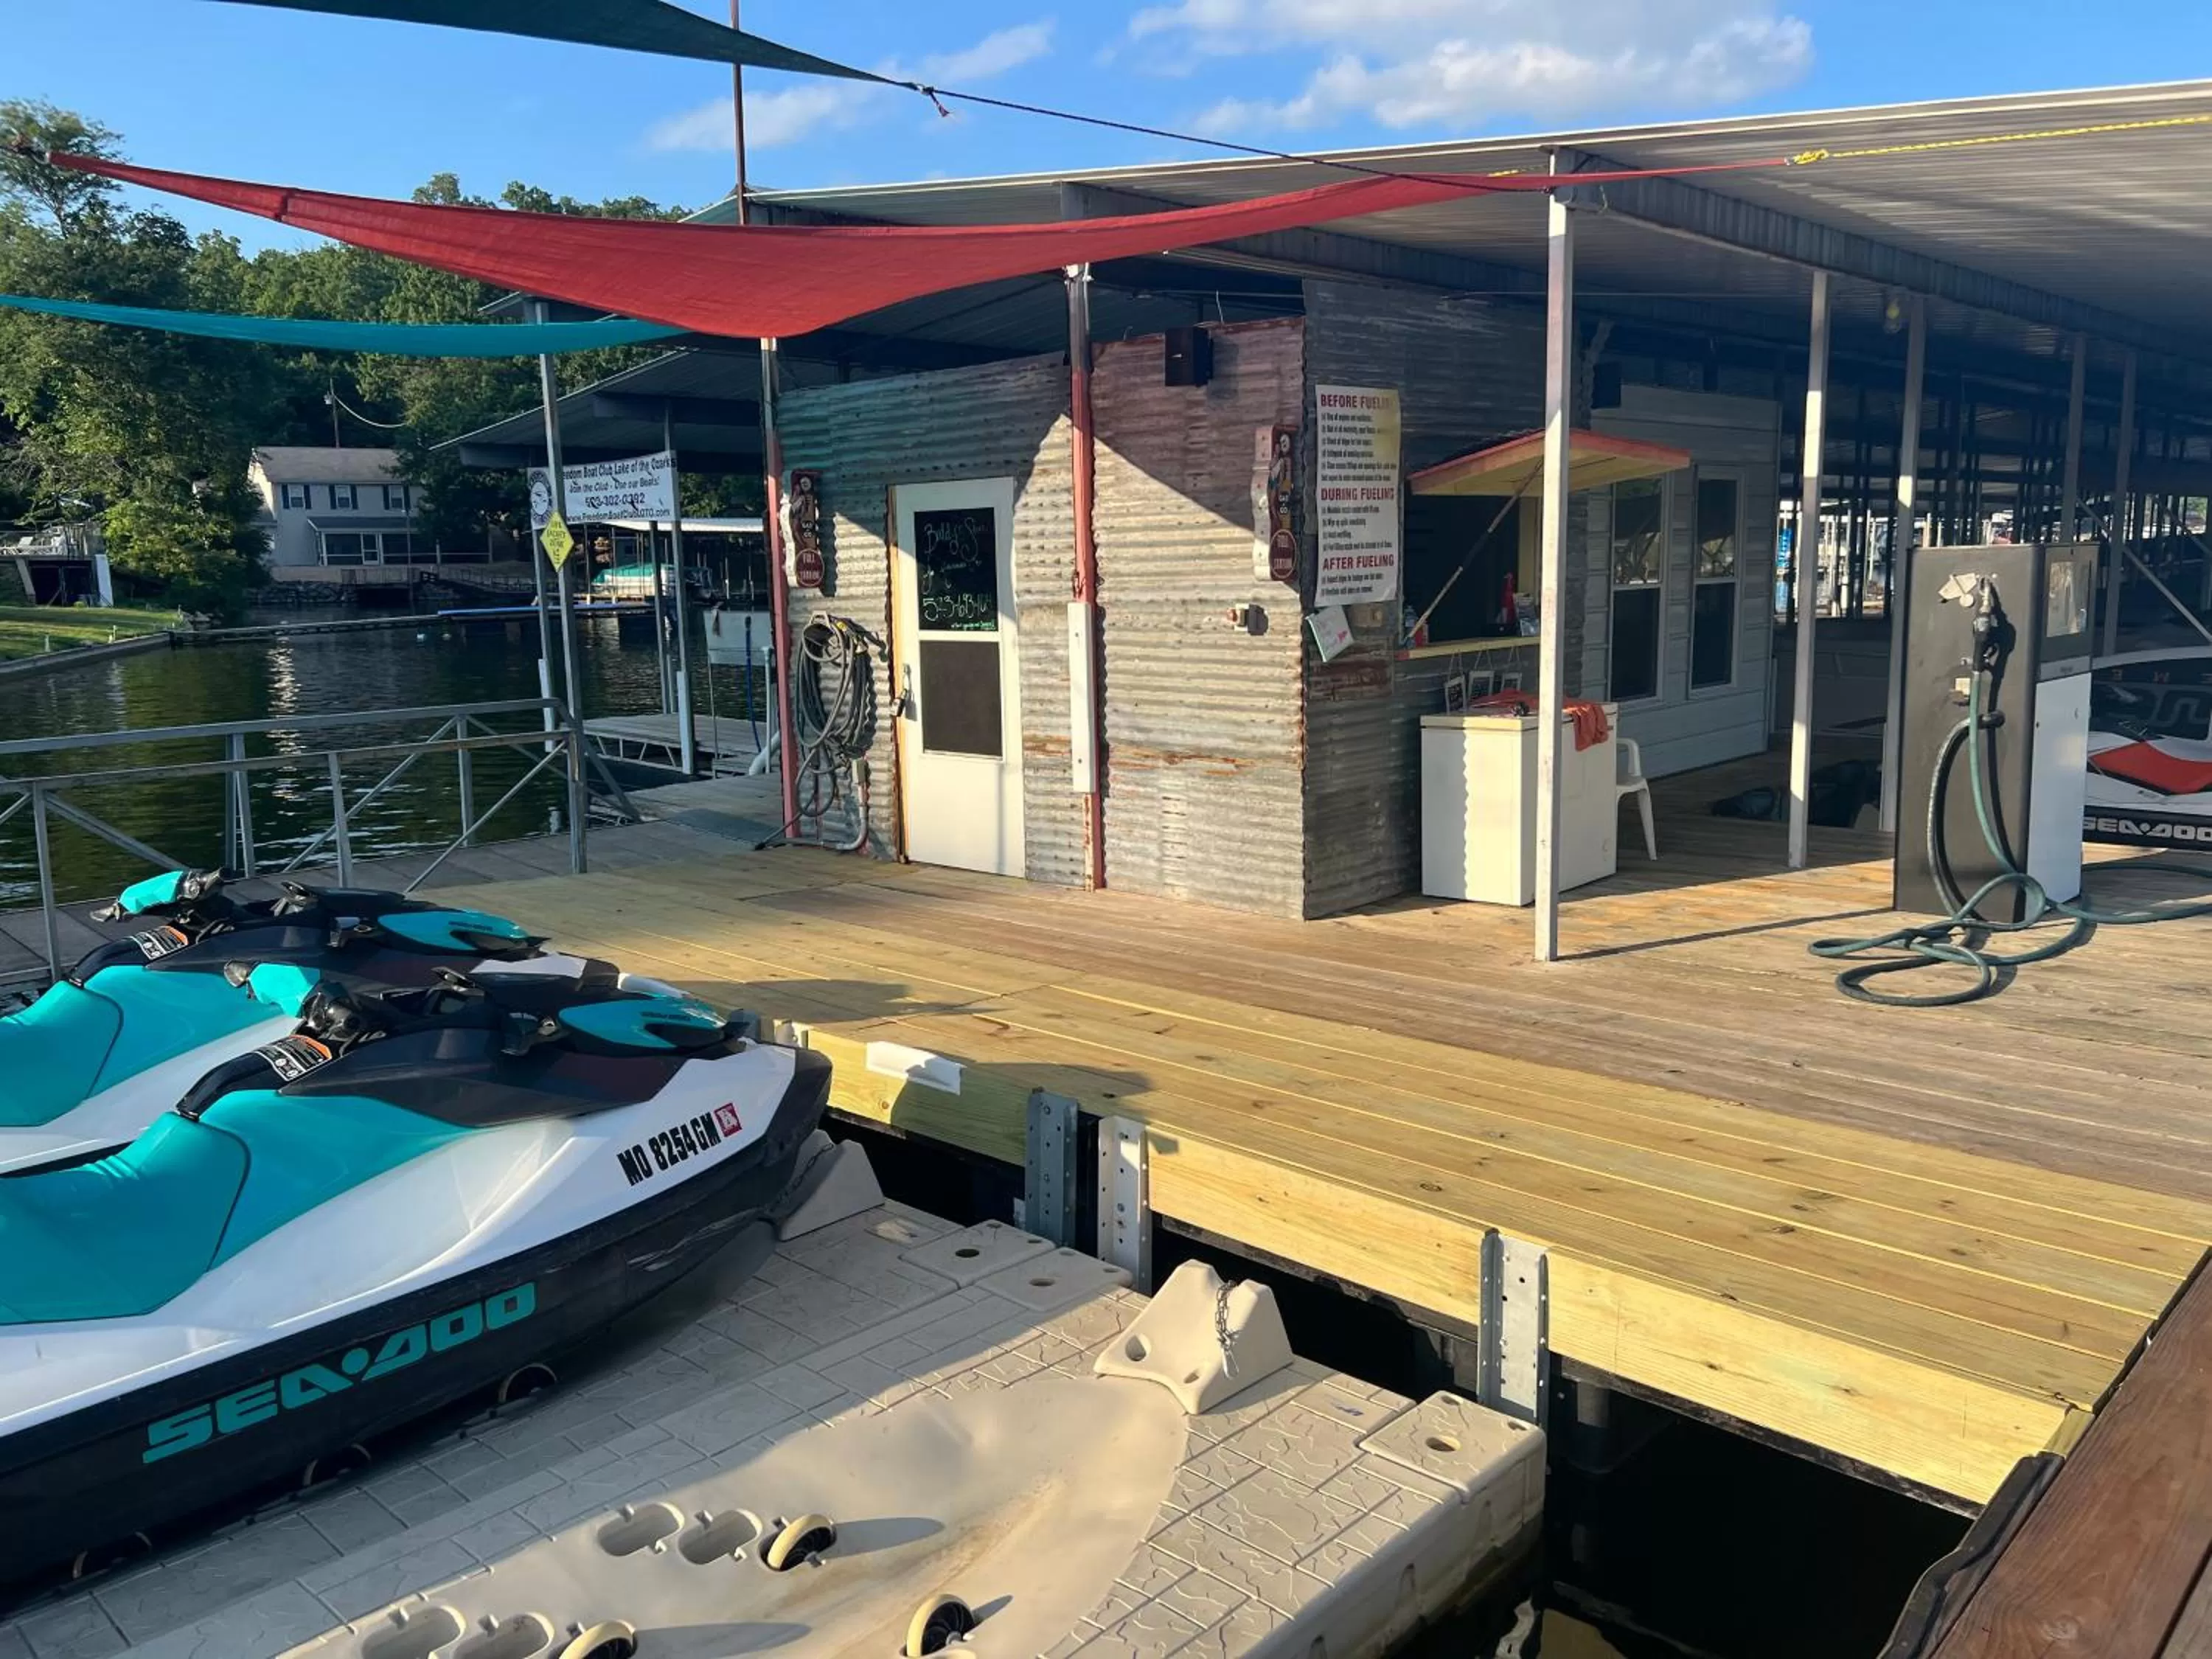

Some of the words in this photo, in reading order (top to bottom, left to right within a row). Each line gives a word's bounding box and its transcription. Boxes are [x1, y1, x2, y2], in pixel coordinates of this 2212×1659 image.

[1321, 394, 1357, 407] BEFORE
[1360, 395, 1391, 408] FUELIN
[584, 466, 597, 478] Boat
[599, 464, 613, 476] Club
[614, 462, 629, 474] Lake
[631, 460, 638, 472] of
[639, 459, 649, 471] the
[651, 456, 676, 470] Ozarks
[1321, 487, 1357, 501] DURING
[1360, 487, 1394, 501] FUELING
[1323, 557, 1353, 571] AFTER
[1356, 554, 1394, 568] FUELING
[616, 1144, 653, 1186] MO
